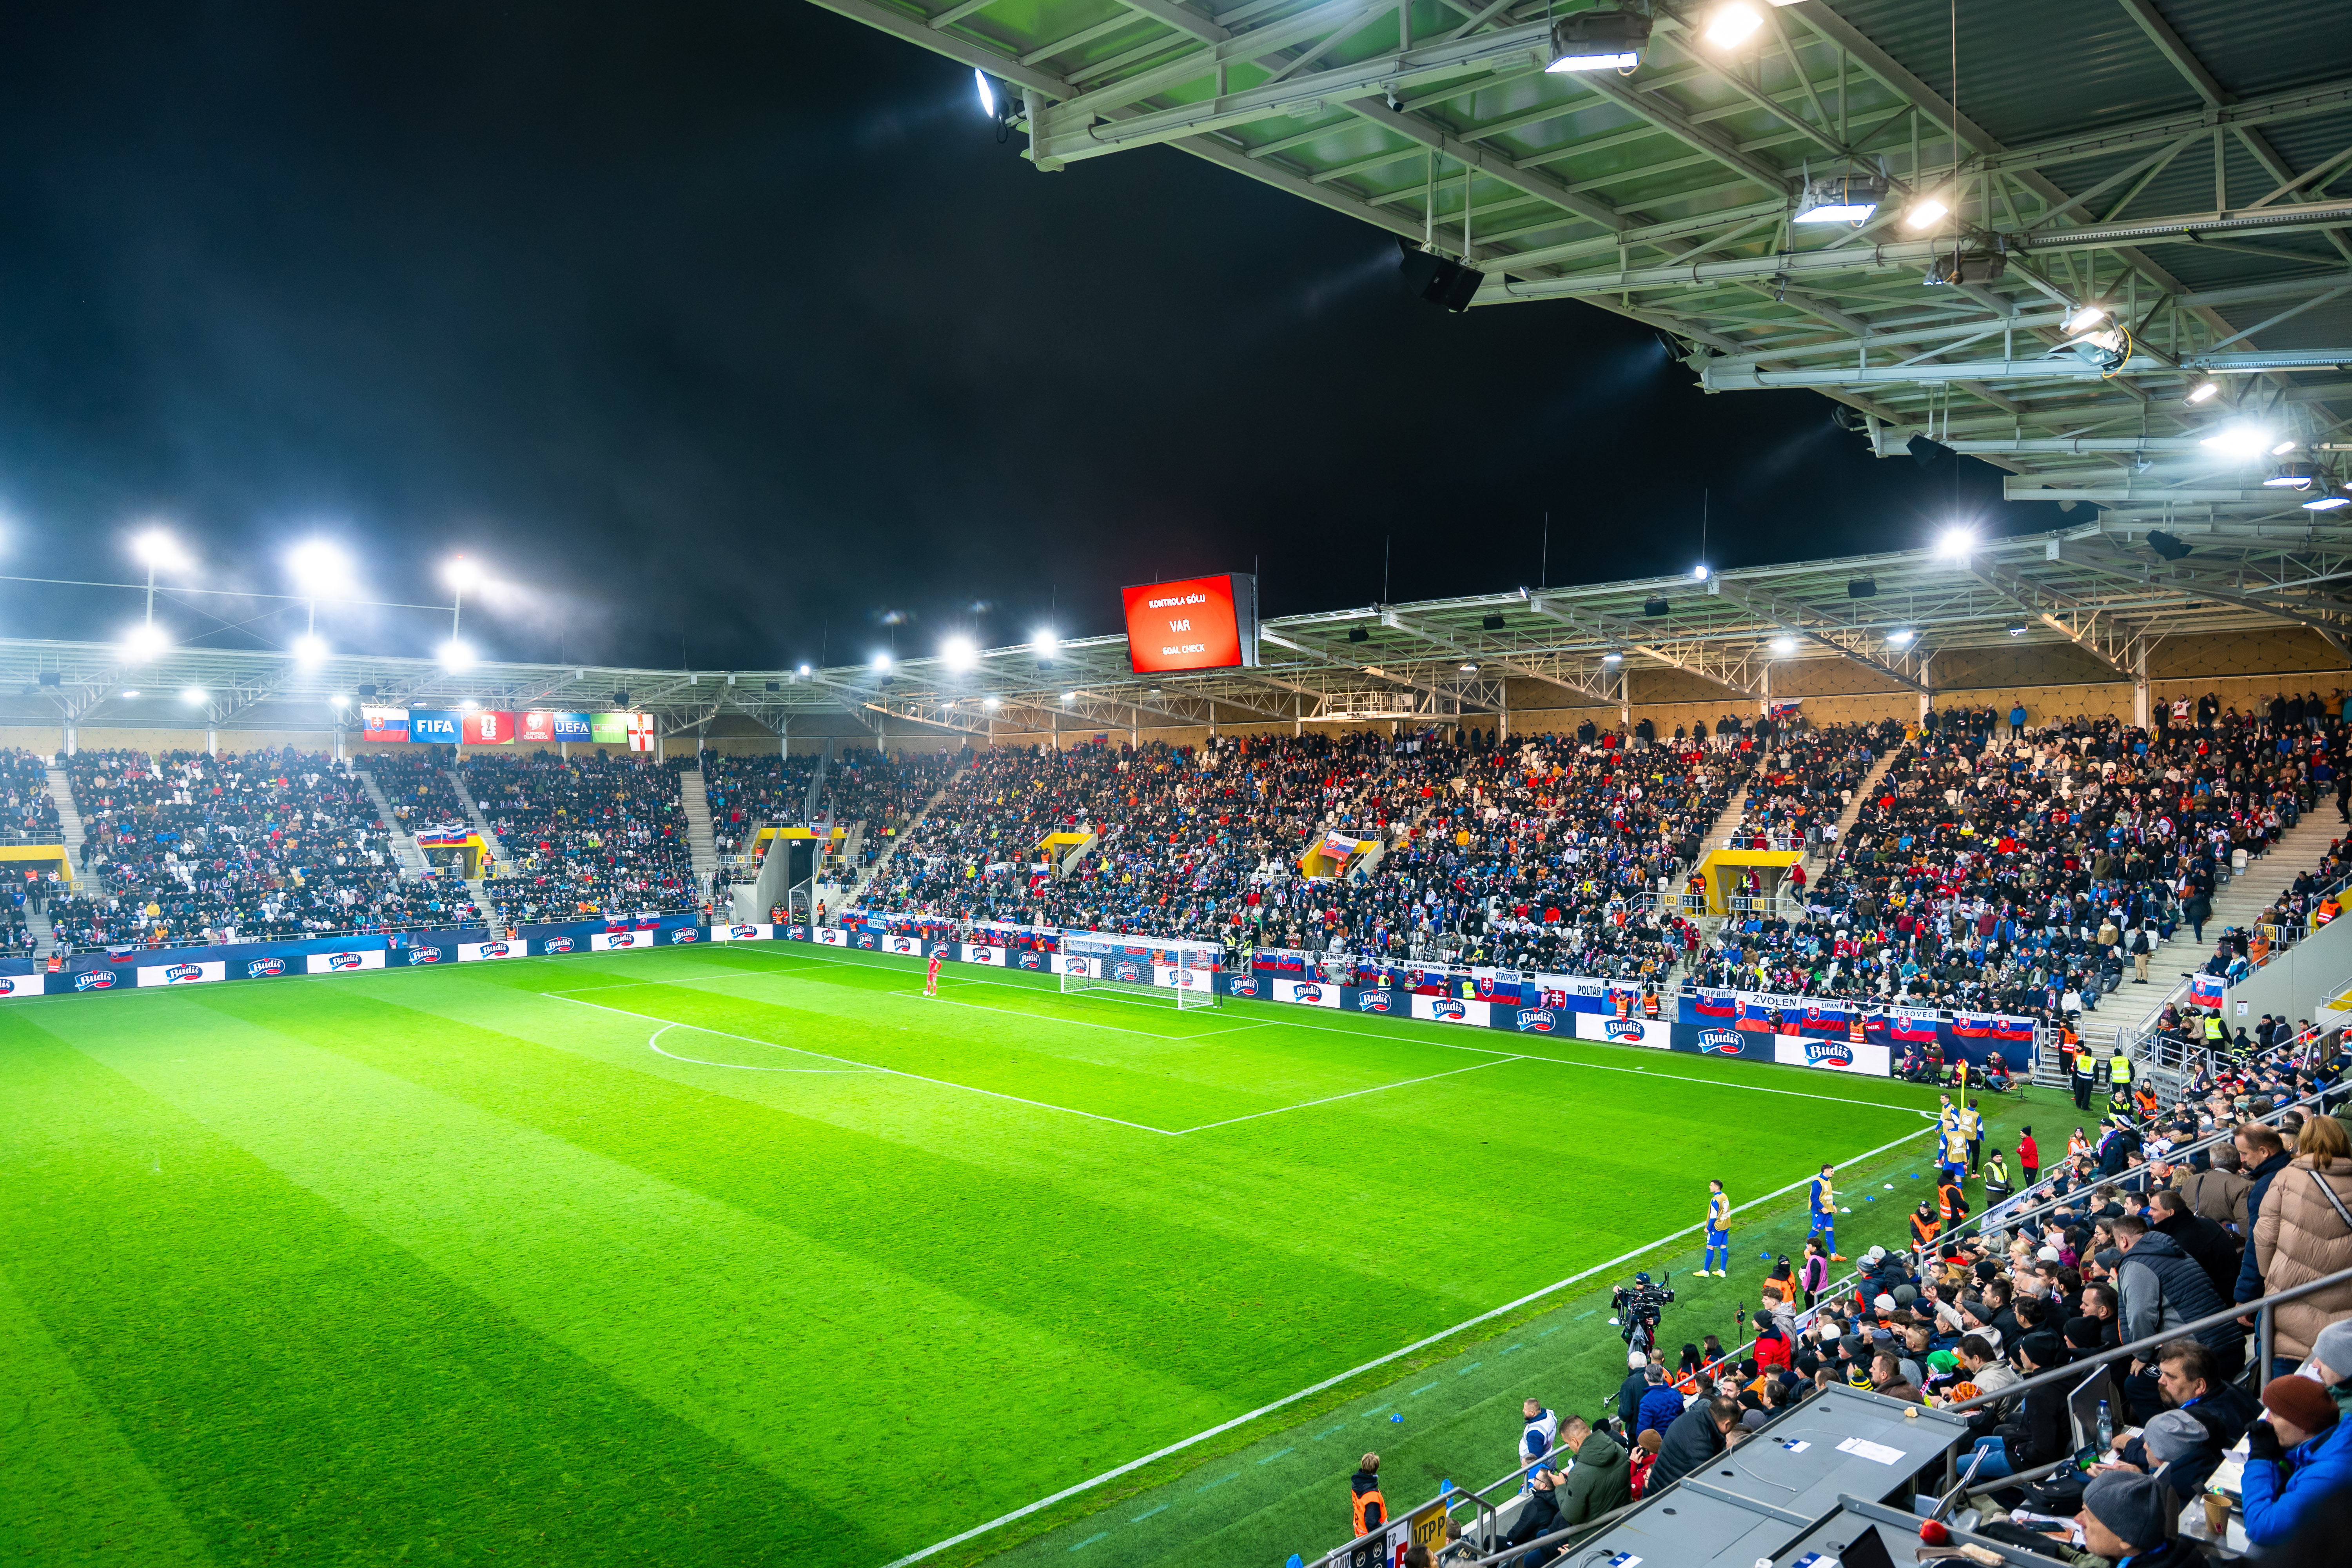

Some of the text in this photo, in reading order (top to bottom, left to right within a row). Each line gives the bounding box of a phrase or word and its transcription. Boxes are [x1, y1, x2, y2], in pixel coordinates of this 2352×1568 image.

[1149, 593, 1205, 608] KONTROLA GÓLU
[1169, 619, 1191, 632] VAR
[1162, 643, 1205, 655] GOAL CHECK
[417, 720, 454, 733] FIFA
[555, 722, 589, 733] UEFA
[1754, 900, 1762, 908] B1
[675, 929, 695, 939] Budiš
[734, 927, 755, 936] Budiš
[789, 927, 803, 935] Budiš
[2265, 927, 2274, 939] AB
[549, 939, 571, 949] Budiš
[611, 934, 632, 944] Budiš
[896, 939, 909, 947] Budiš
[483, 944, 506, 954] Budiš
[933, 944, 947, 952] Budiš
[975, 947, 990, 957] Budiš
[413, 949, 437, 959] Budiš
[1022, 953, 1038, 963] Budiš
[253, 960, 281, 972] Budiš
[332, 955, 359, 966] Budiš
[170, 966, 200, 978] Budiš
[1172, 971, 1191, 981] Bdiš
[1495, 972, 1519, 982] STROPKOV
[80, 973, 111, 985] Budiš
[1234, 978, 1256, 989] Budiš
[1296, 985, 1319, 996] Budiš
[1577, 984, 1601, 996] POLTÁR
[1363, 993, 1388, 1004] Budiš
[1753, 995, 1797, 1006] ZVOLEN
[1436, 1002, 1463, 1013] Budiš
[1522, 1012, 1551, 1024] Budiš
[1895, 1009, 1933, 1018] TISOVEC
[1609, 1022, 1641, 1034] Budiš
[1704, 1032, 1739, 1045] Budiš
[1809, 1045, 1848, 1058] Budiš
